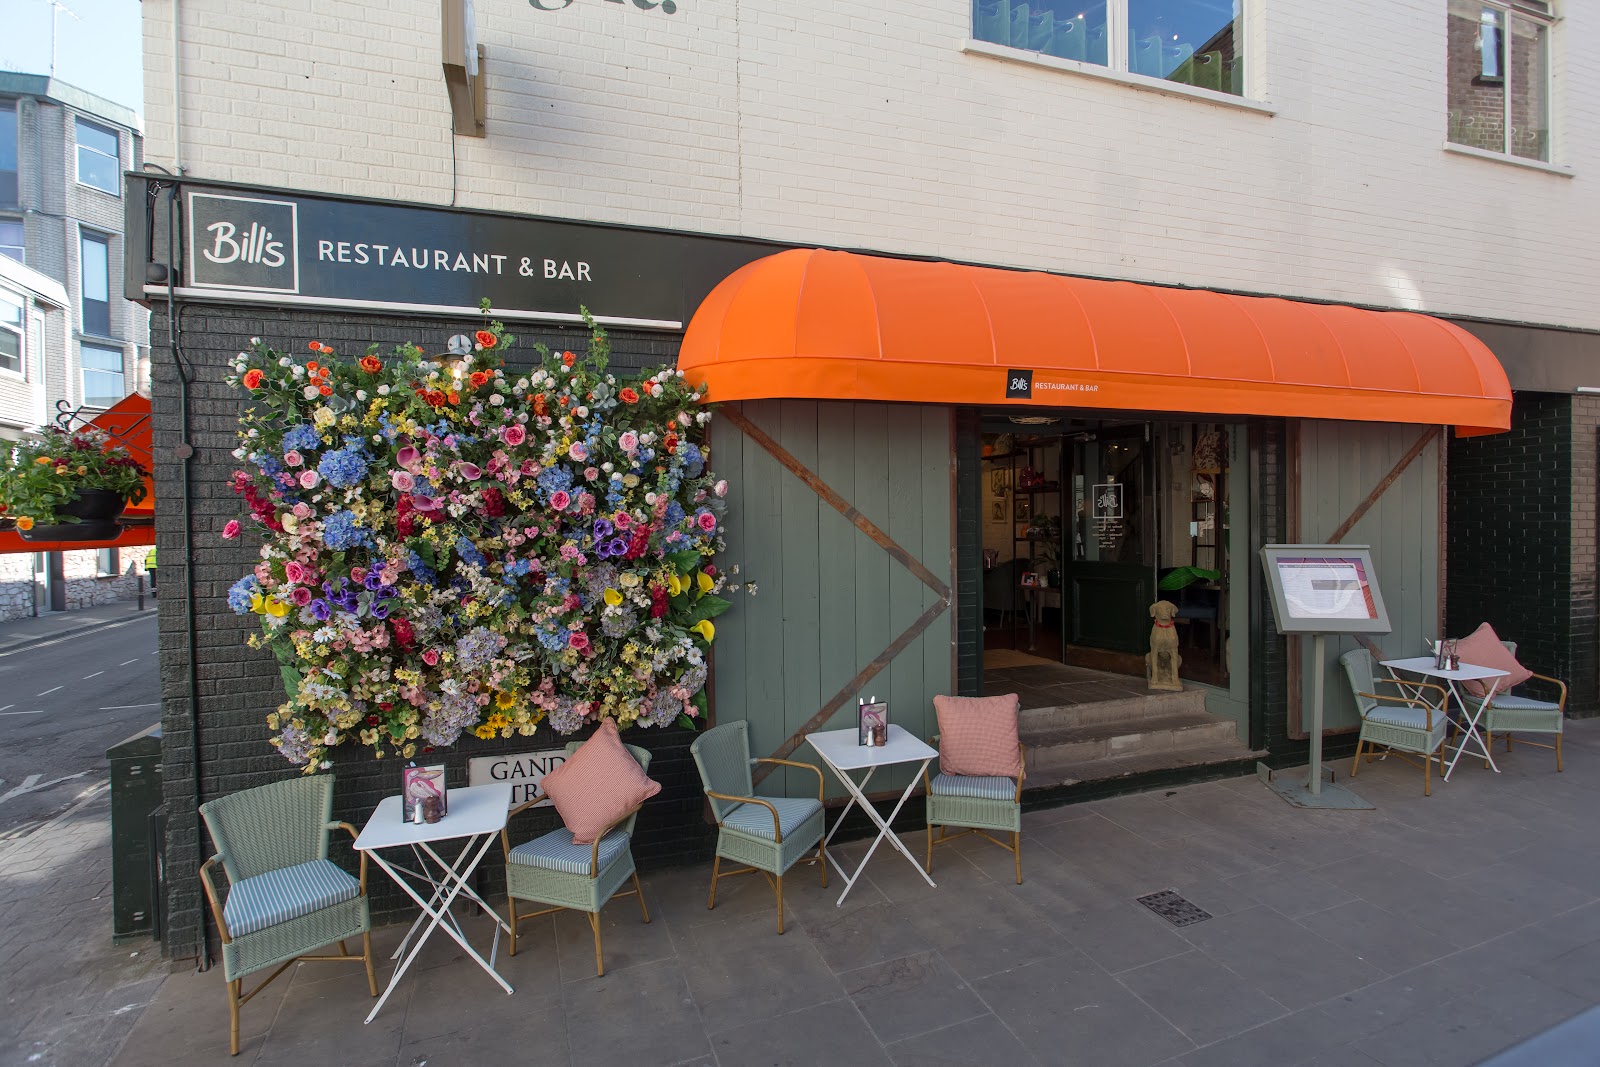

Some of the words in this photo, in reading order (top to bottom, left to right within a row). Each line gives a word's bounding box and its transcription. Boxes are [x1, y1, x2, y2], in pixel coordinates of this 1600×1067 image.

[203, 221, 285, 267] Bill's
[318, 240, 507, 275] RESTAURANT
[518, 256, 534, 277] &
[543, 258, 592, 282] BAR
[1009, 377, 1028, 391] Bill's
[1034, 382, 1079, 391] RESTAURANT
[1079, 383, 1085, 392] &
[1085, 384, 1099, 392] BAR
